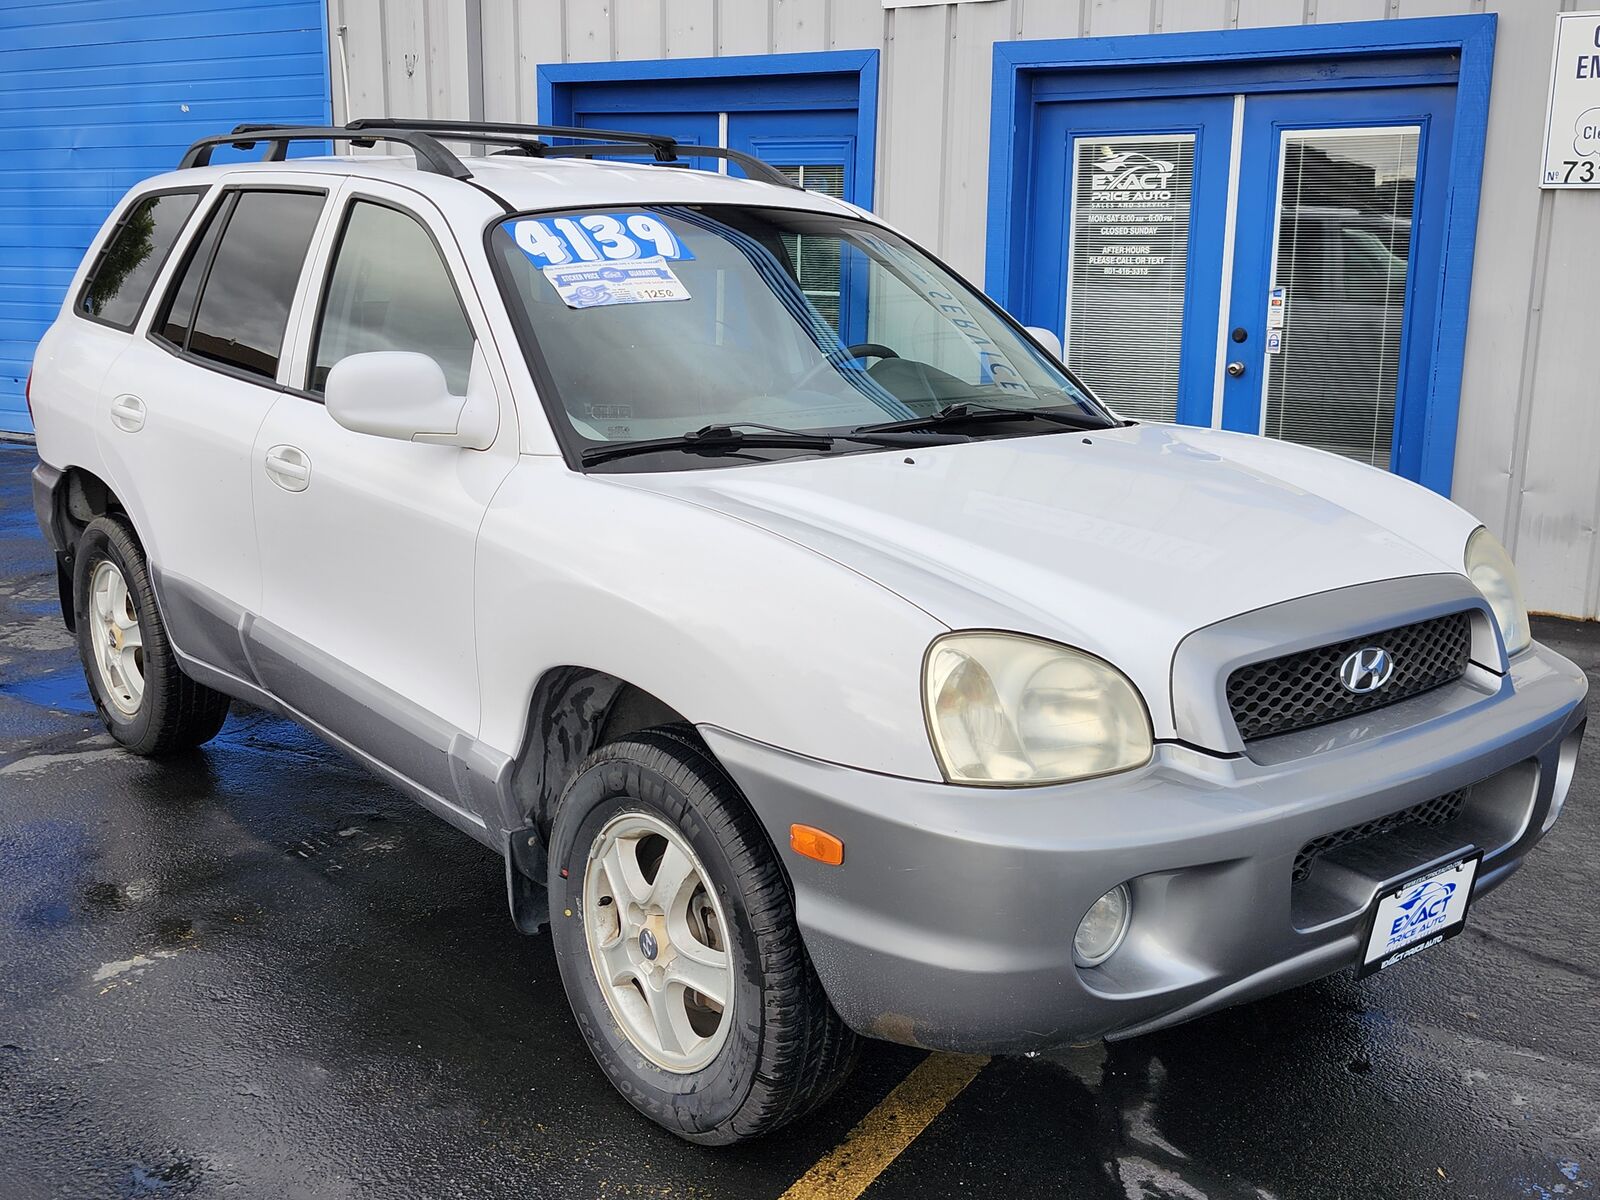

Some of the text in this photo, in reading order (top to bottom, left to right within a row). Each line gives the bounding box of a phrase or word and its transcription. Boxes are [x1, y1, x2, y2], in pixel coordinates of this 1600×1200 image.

[1563, 160, 1600, 183] 73
[1092, 172, 1174, 190] EXACT
[1091, 190, 1172, 201] PRICE AUTO
[514, 214, 681, 265] 4139
[1100, 226, 1158, 235] CLOSED SUNDAY
[1125, 246, 1150, 254] HOURS
[1088, 256, 1166, 265] PLEASE CALL OR TEXT
[561, 273, 584, 283] STICKER
[584, 272, 600, 281] PRICE
[1390, 894, 1454, 936] EXACT
[1386, 926, 1418, 947] PRICE
[1418, 914, 1447, 932] AUTO
[1380, 951, 1406, 970] EXACT
[1403, 943, 1426, 959] PRICE
[1424, 934, 1444, 950] AUTO
